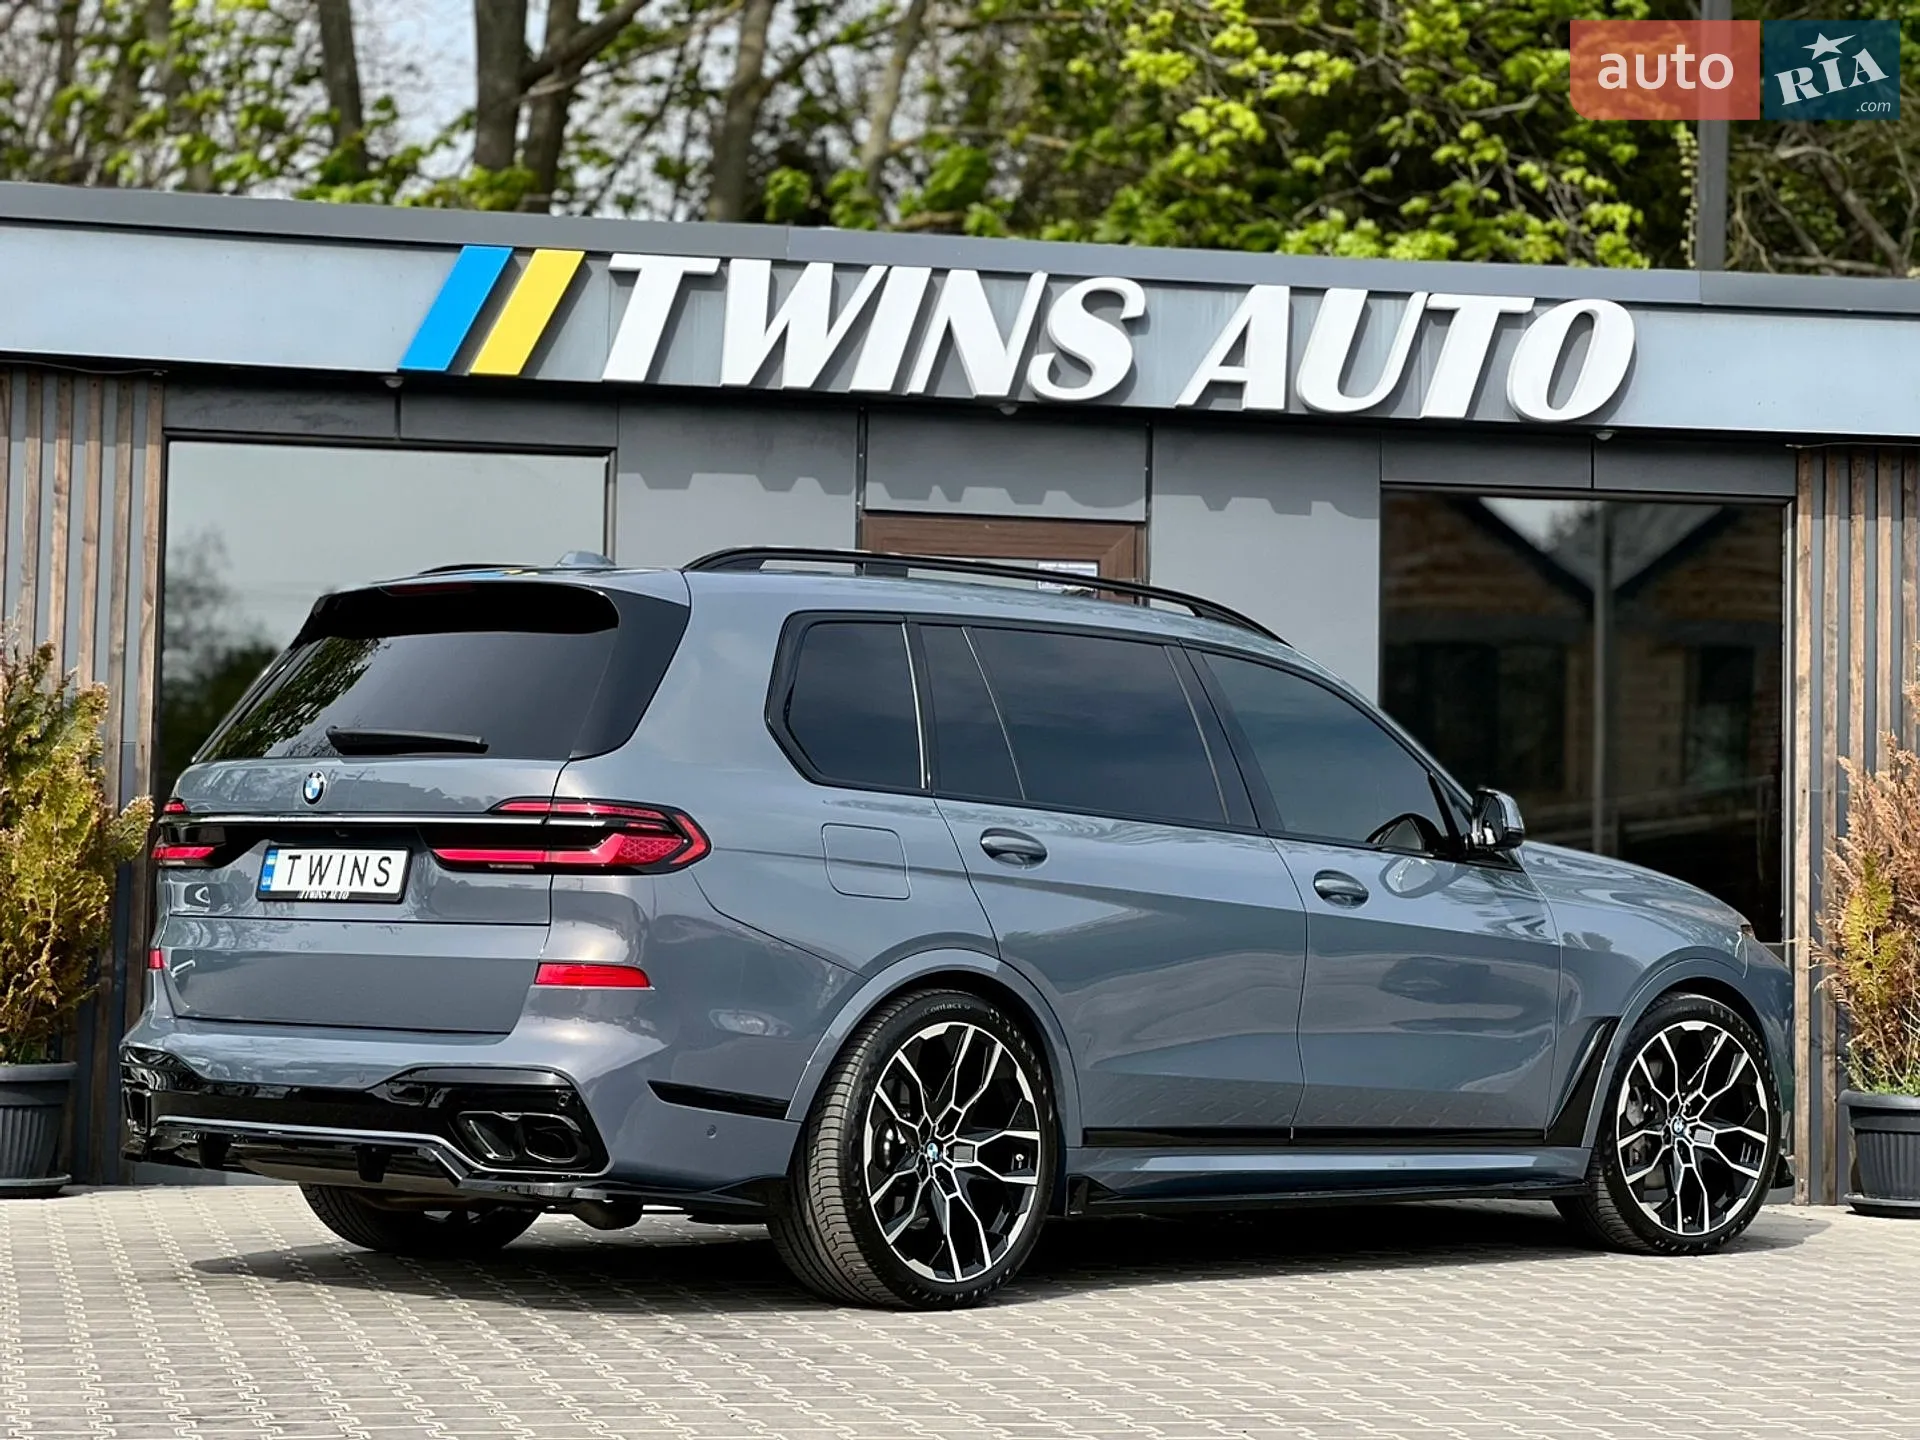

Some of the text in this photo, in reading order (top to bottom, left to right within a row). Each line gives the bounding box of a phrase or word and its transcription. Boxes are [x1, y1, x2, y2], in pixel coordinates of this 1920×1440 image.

[601, 253, 1636, 423] TWINS AUTO
[287, 854, 392, 887] TWINS
